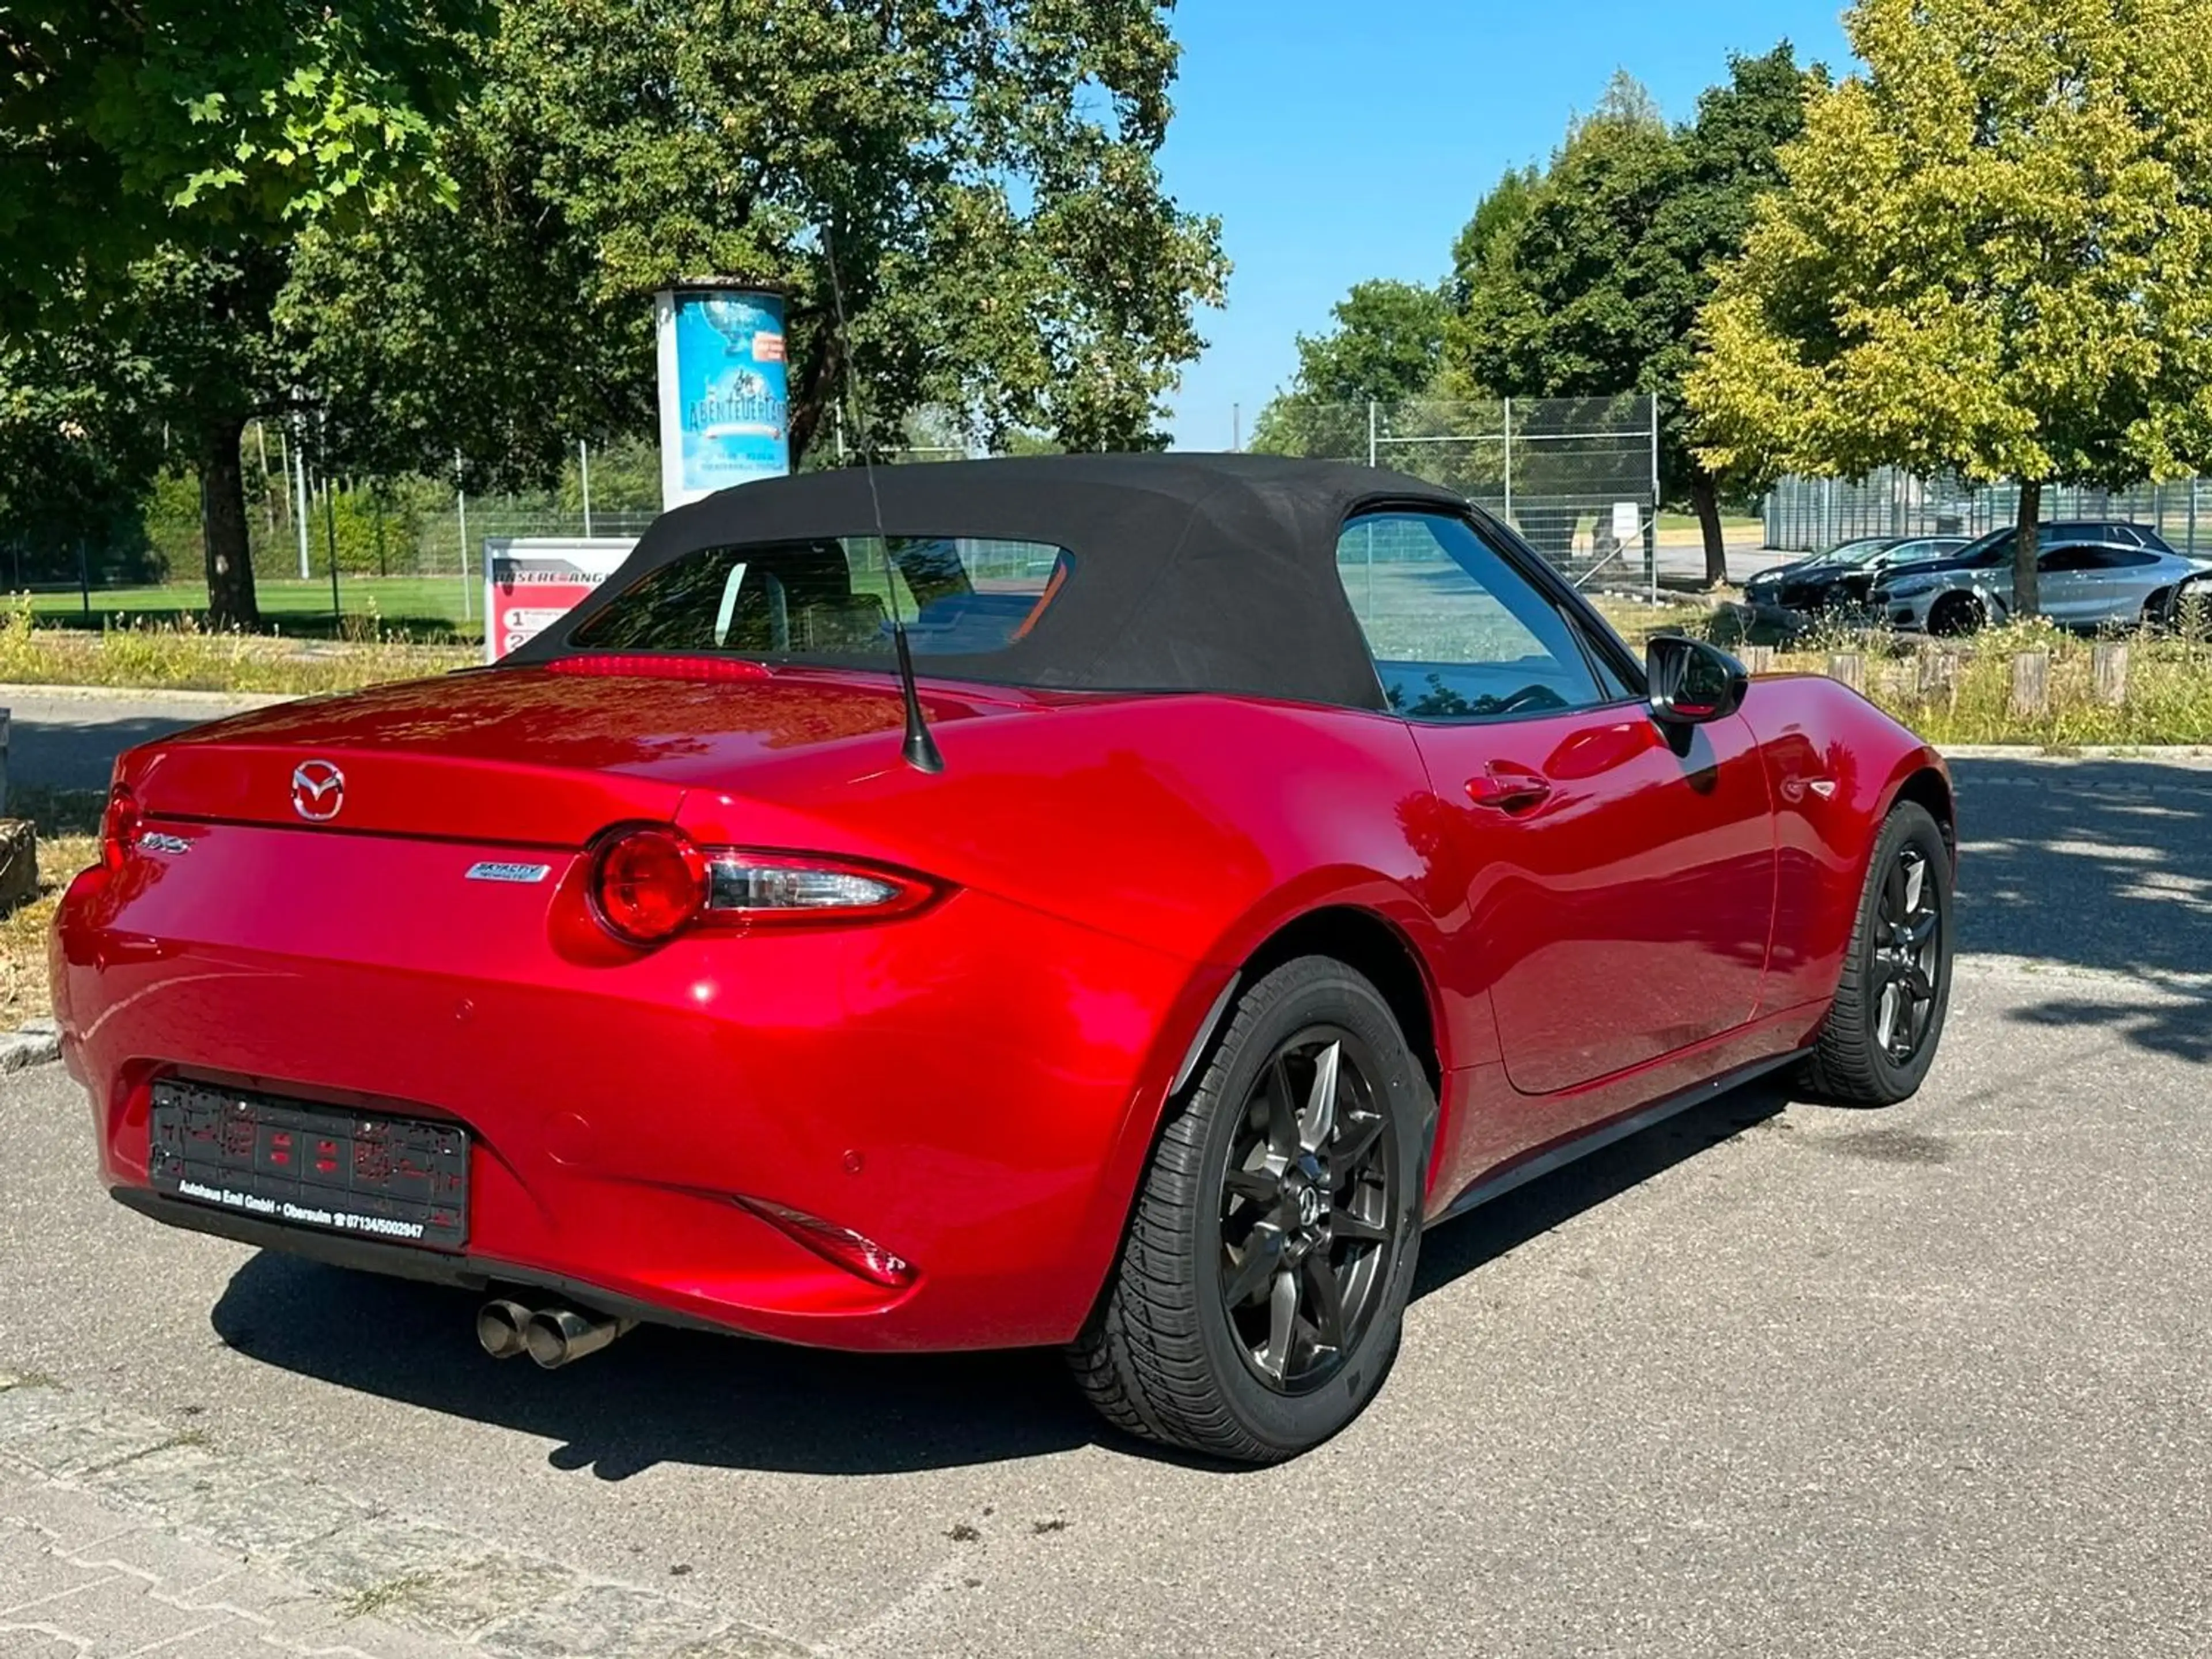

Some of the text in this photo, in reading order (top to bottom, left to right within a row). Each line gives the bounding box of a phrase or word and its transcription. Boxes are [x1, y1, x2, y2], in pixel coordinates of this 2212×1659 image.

[512, 612, 523, 626] 1
[179, 1180, 221, 1201] Autohaus
[222, 1190, 244, 1206] Emil
[245, 1195, 275, 1213] GmbH
